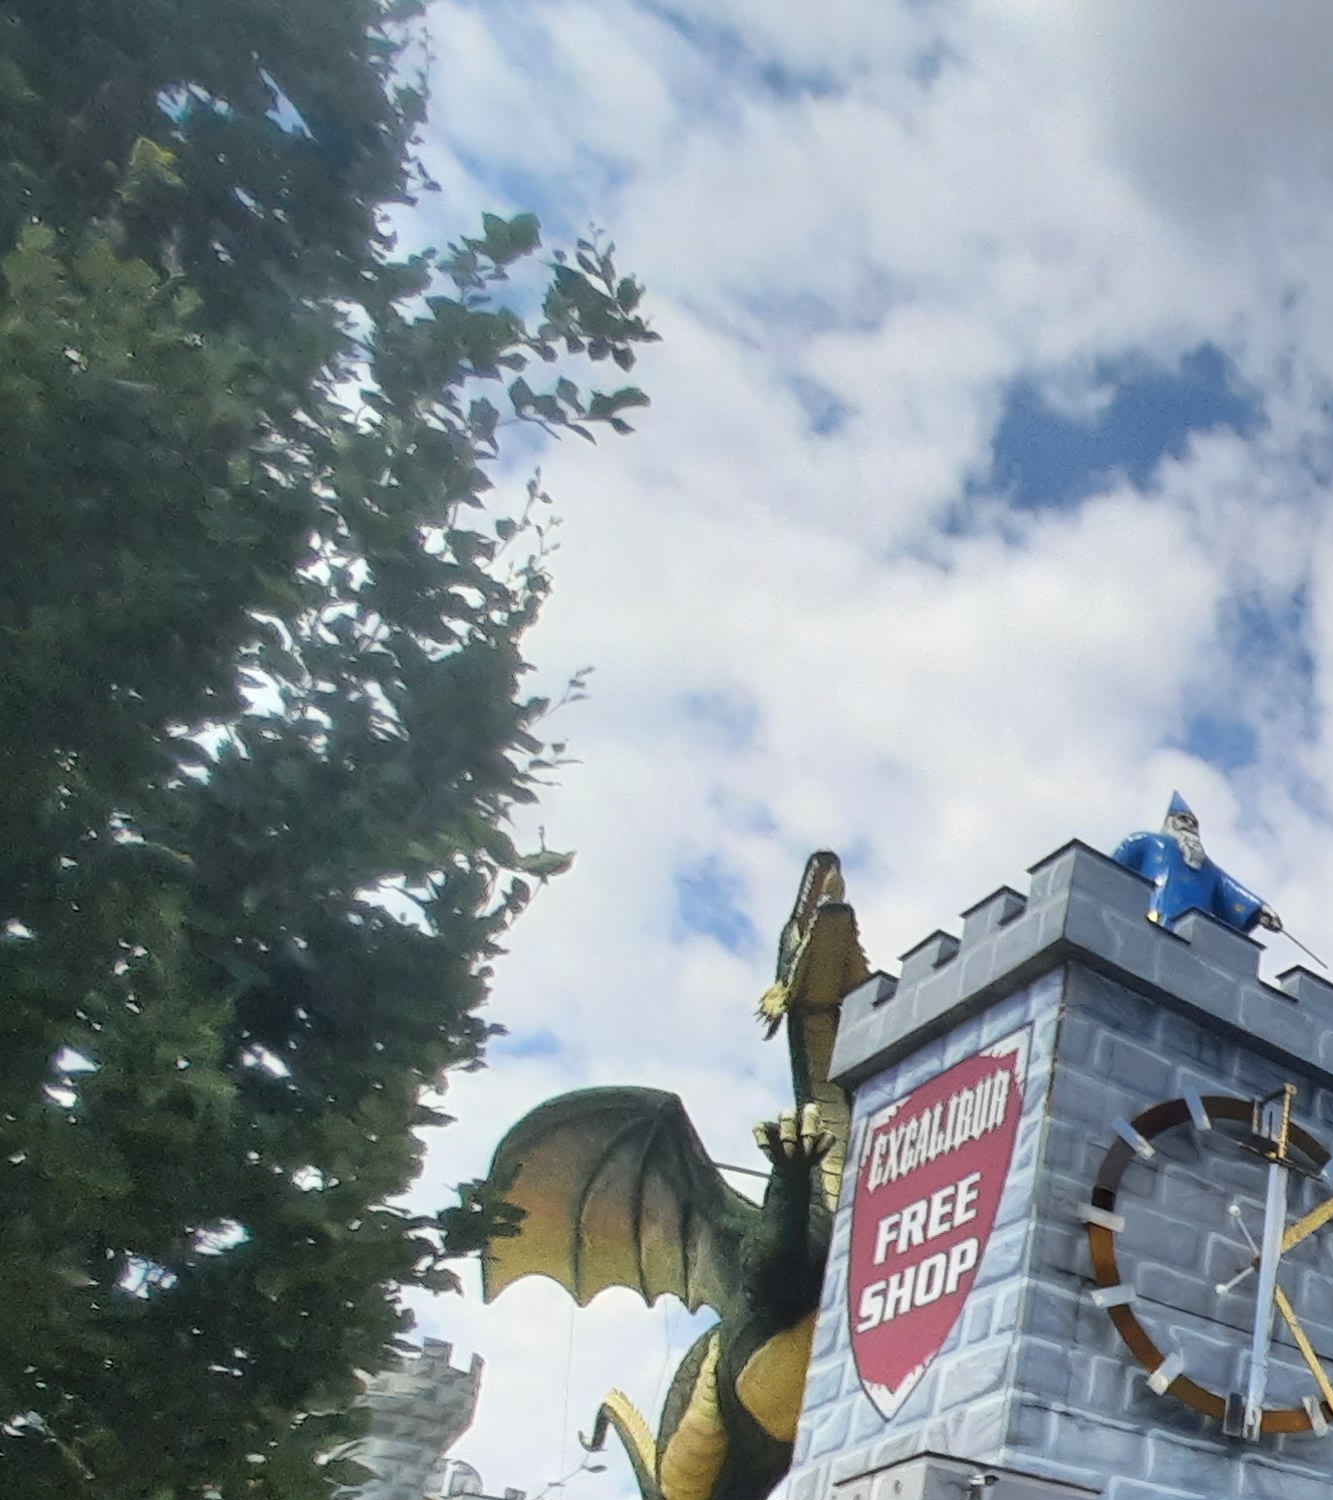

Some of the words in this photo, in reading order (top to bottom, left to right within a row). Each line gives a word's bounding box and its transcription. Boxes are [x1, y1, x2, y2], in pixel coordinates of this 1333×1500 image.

[867, 1069, 1011, 1194] EXCALIBUR
[874, 1172, 981, 1266] FREE
[857, 1237, 980, 1333] SHOP
